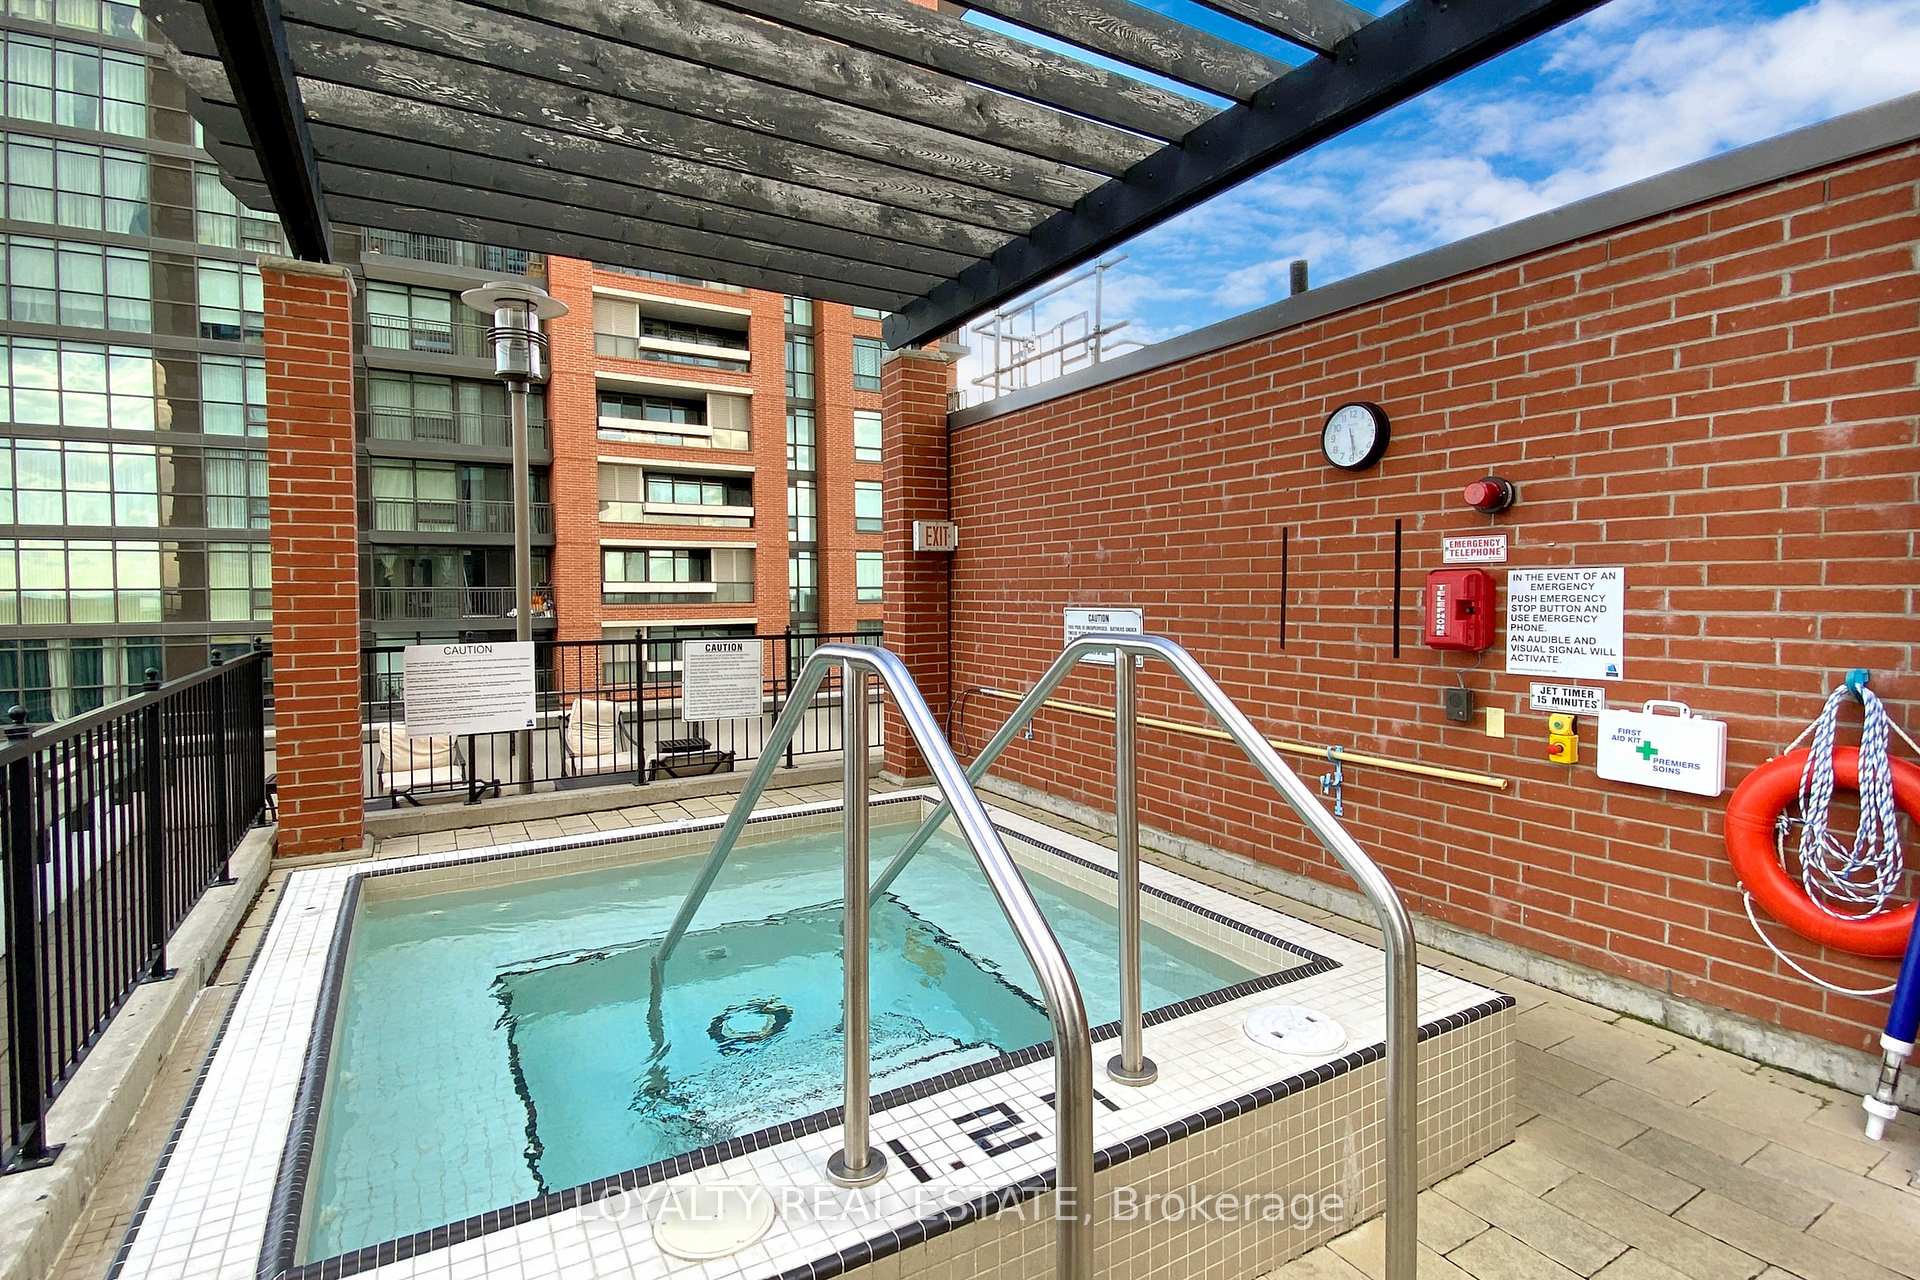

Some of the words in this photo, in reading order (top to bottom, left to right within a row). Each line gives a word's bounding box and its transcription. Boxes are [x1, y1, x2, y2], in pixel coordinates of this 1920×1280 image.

[926, 526, 949, 546] EXIT
[1449, 538, 1501, 549] EMERGENCY
[1450, 547, 1501, 557] TELEPHONE
[1512, 574, 1522, 582] IN
[1525, 573, 1544, 581] THE
[1547, 573, 1580, 581] EVENT
[1583, 572, 1598, 581] OF
[1600, 571, 1616, 580] AN
[1530, 582, 1595, 591] EMERGENCY
[1511, 595, 1537, 603] PUSH
[1540, 594, 1606, 603] EMERGENCY
[1436, 584, 1446, 636] TELEPHONE
[1511, 604, 1537, 612] STOP
[1540, 605, 1581, 613] BUTTON
[1584, 605, 1608, 613] AND
[1088, 613, 1110, 623] CAUTION
[1511, 614, 1530, 622] USE
[1532, 614, 1598, 623] EMERGENCY
[1510, 624, 1547, 632] PHONE.
[1527, 635, 1571, 644] AUDIBLE
[1574, 637, 1597, 645] AND
[443, 645, 493, 655] CAUTION
[705, 643, 743, 652] CAUTION
[1511, 645, 1546, 653] VISUAL
[1549, 646, 1587, 655] SIGNAL
[1590, 647, 1617, 656] WILL
[1510, 654, 1562, 664] ACTIVATE.
[1540, 686, 1557, 695] JET
[1562, 688, 1594, 699] TIMER
[1537, 695, 1547, 704] 15
[1552, 696, 1598, 709] MINUTES
[1617, 727, 1642, 737] FIRST
[1611, 734, 1626, 743] AID
[1627, 735, 1641, 744] KIT
[1652, 757, 1701, 770] PREMIERS
[1652, 765, 1681, 776] SOINS
